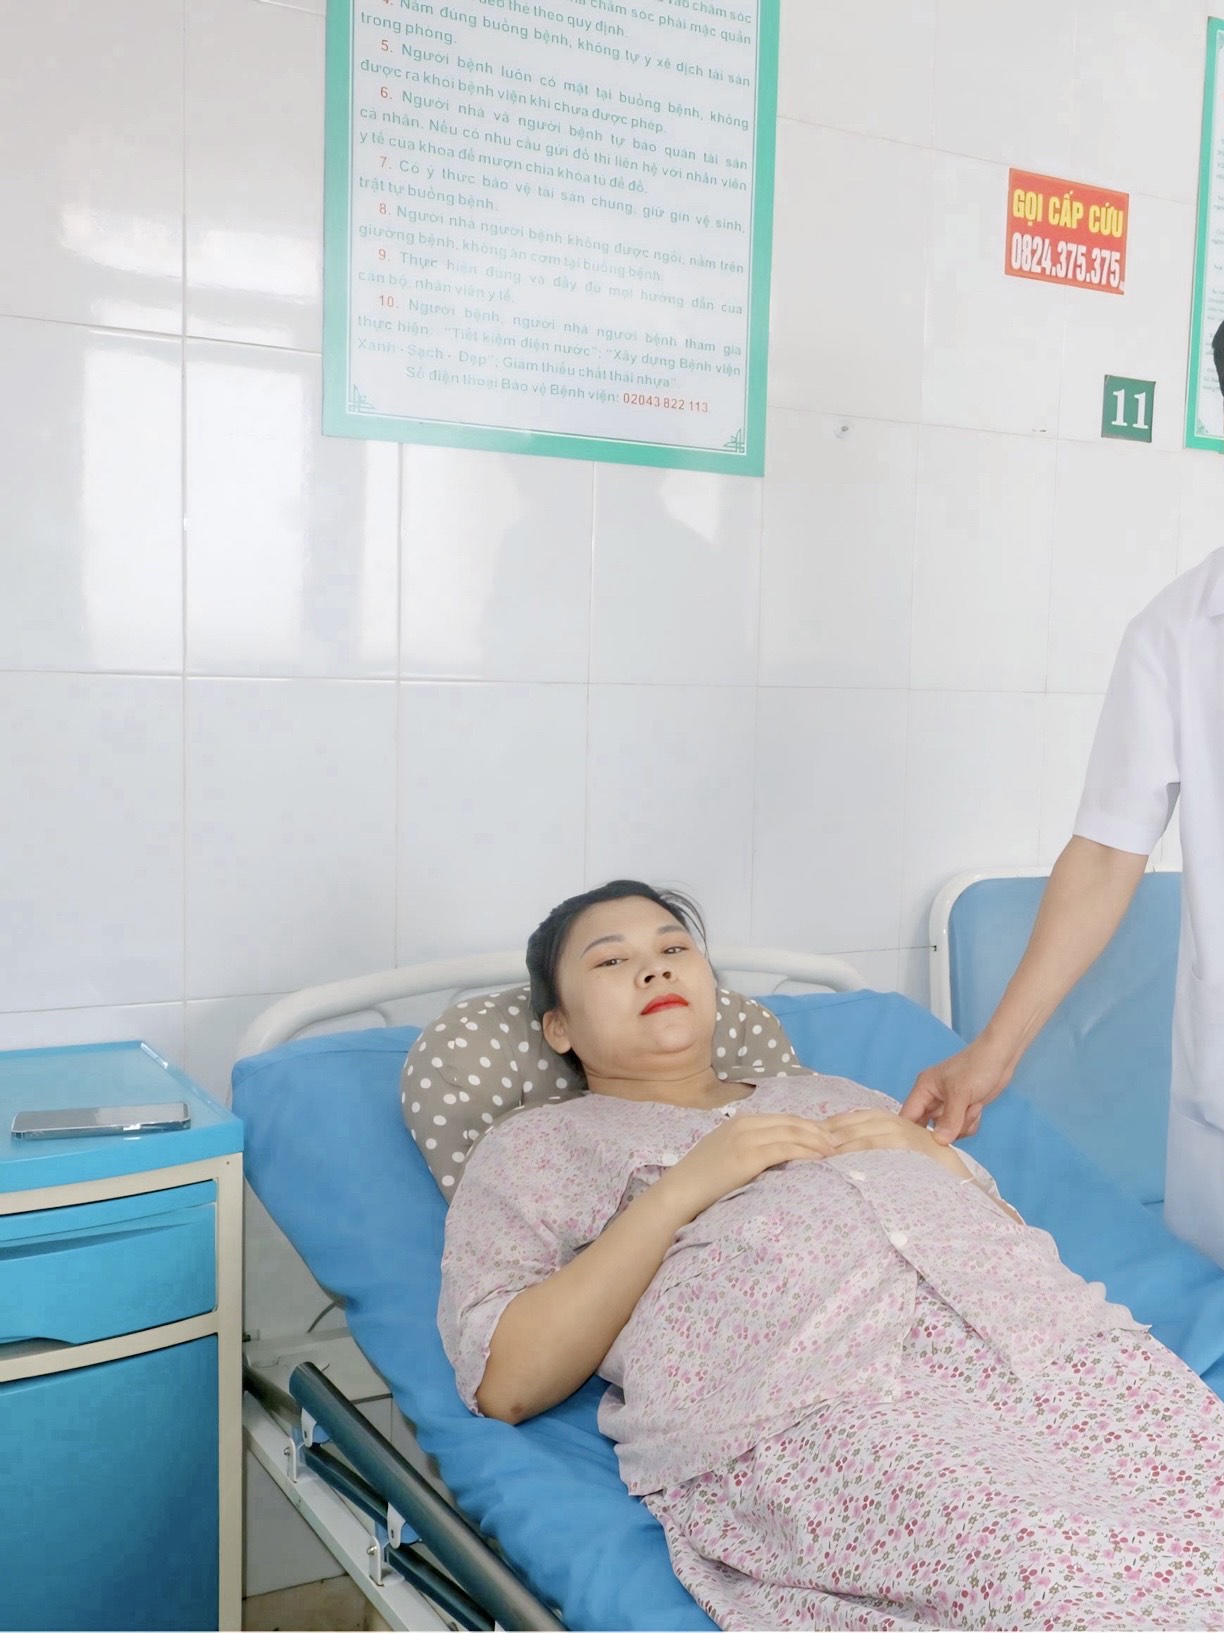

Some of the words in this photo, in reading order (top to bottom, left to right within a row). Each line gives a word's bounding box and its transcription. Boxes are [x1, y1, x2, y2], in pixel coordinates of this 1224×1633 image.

[361, 11, 401, 34] trong
[533, 5, 564, 22] theo
[567, 16, 592, 32] quy
[692, 1, 727, 18] chăm
[578, 37, 620, 61] không
[656, 58, 671, 70] xê
[380, 86, 392, 100] 6.
[381, 39, 393, 53] 5.
[501, 65, 532, 83] luôn
[710, 110, 749, 131] không
[405, 71, 420, 82] ra
[530, 94, 550, 109] khi
[554, 101, 589, 117] chưa
[360, 131, 368, 144] y
[419, 140, 455, 158] khoa
[382, 111, 424, 129] nhân.
[484, 132, 511, 146] nhu
[615, 155, 638, 170] liên
[686, 171, 717, 185] nhân
[721, 178, 747, 191] viên
[380, 156, 392, 170] 7.
[591, 196, 636, 216] chung,
[716, 218, 745, 234] sinh,
[1012, 188, 1043, 226] GỌI
[1048, 190, 1084, 229] CẤP
[1089, 202, 1124, 238] CỨU
[379, 202, 391, 216] 8.
[567, 234, 609, 255] không
[720, 260, 744, 274] trên
[1111, 388, 1149, 430] 11
